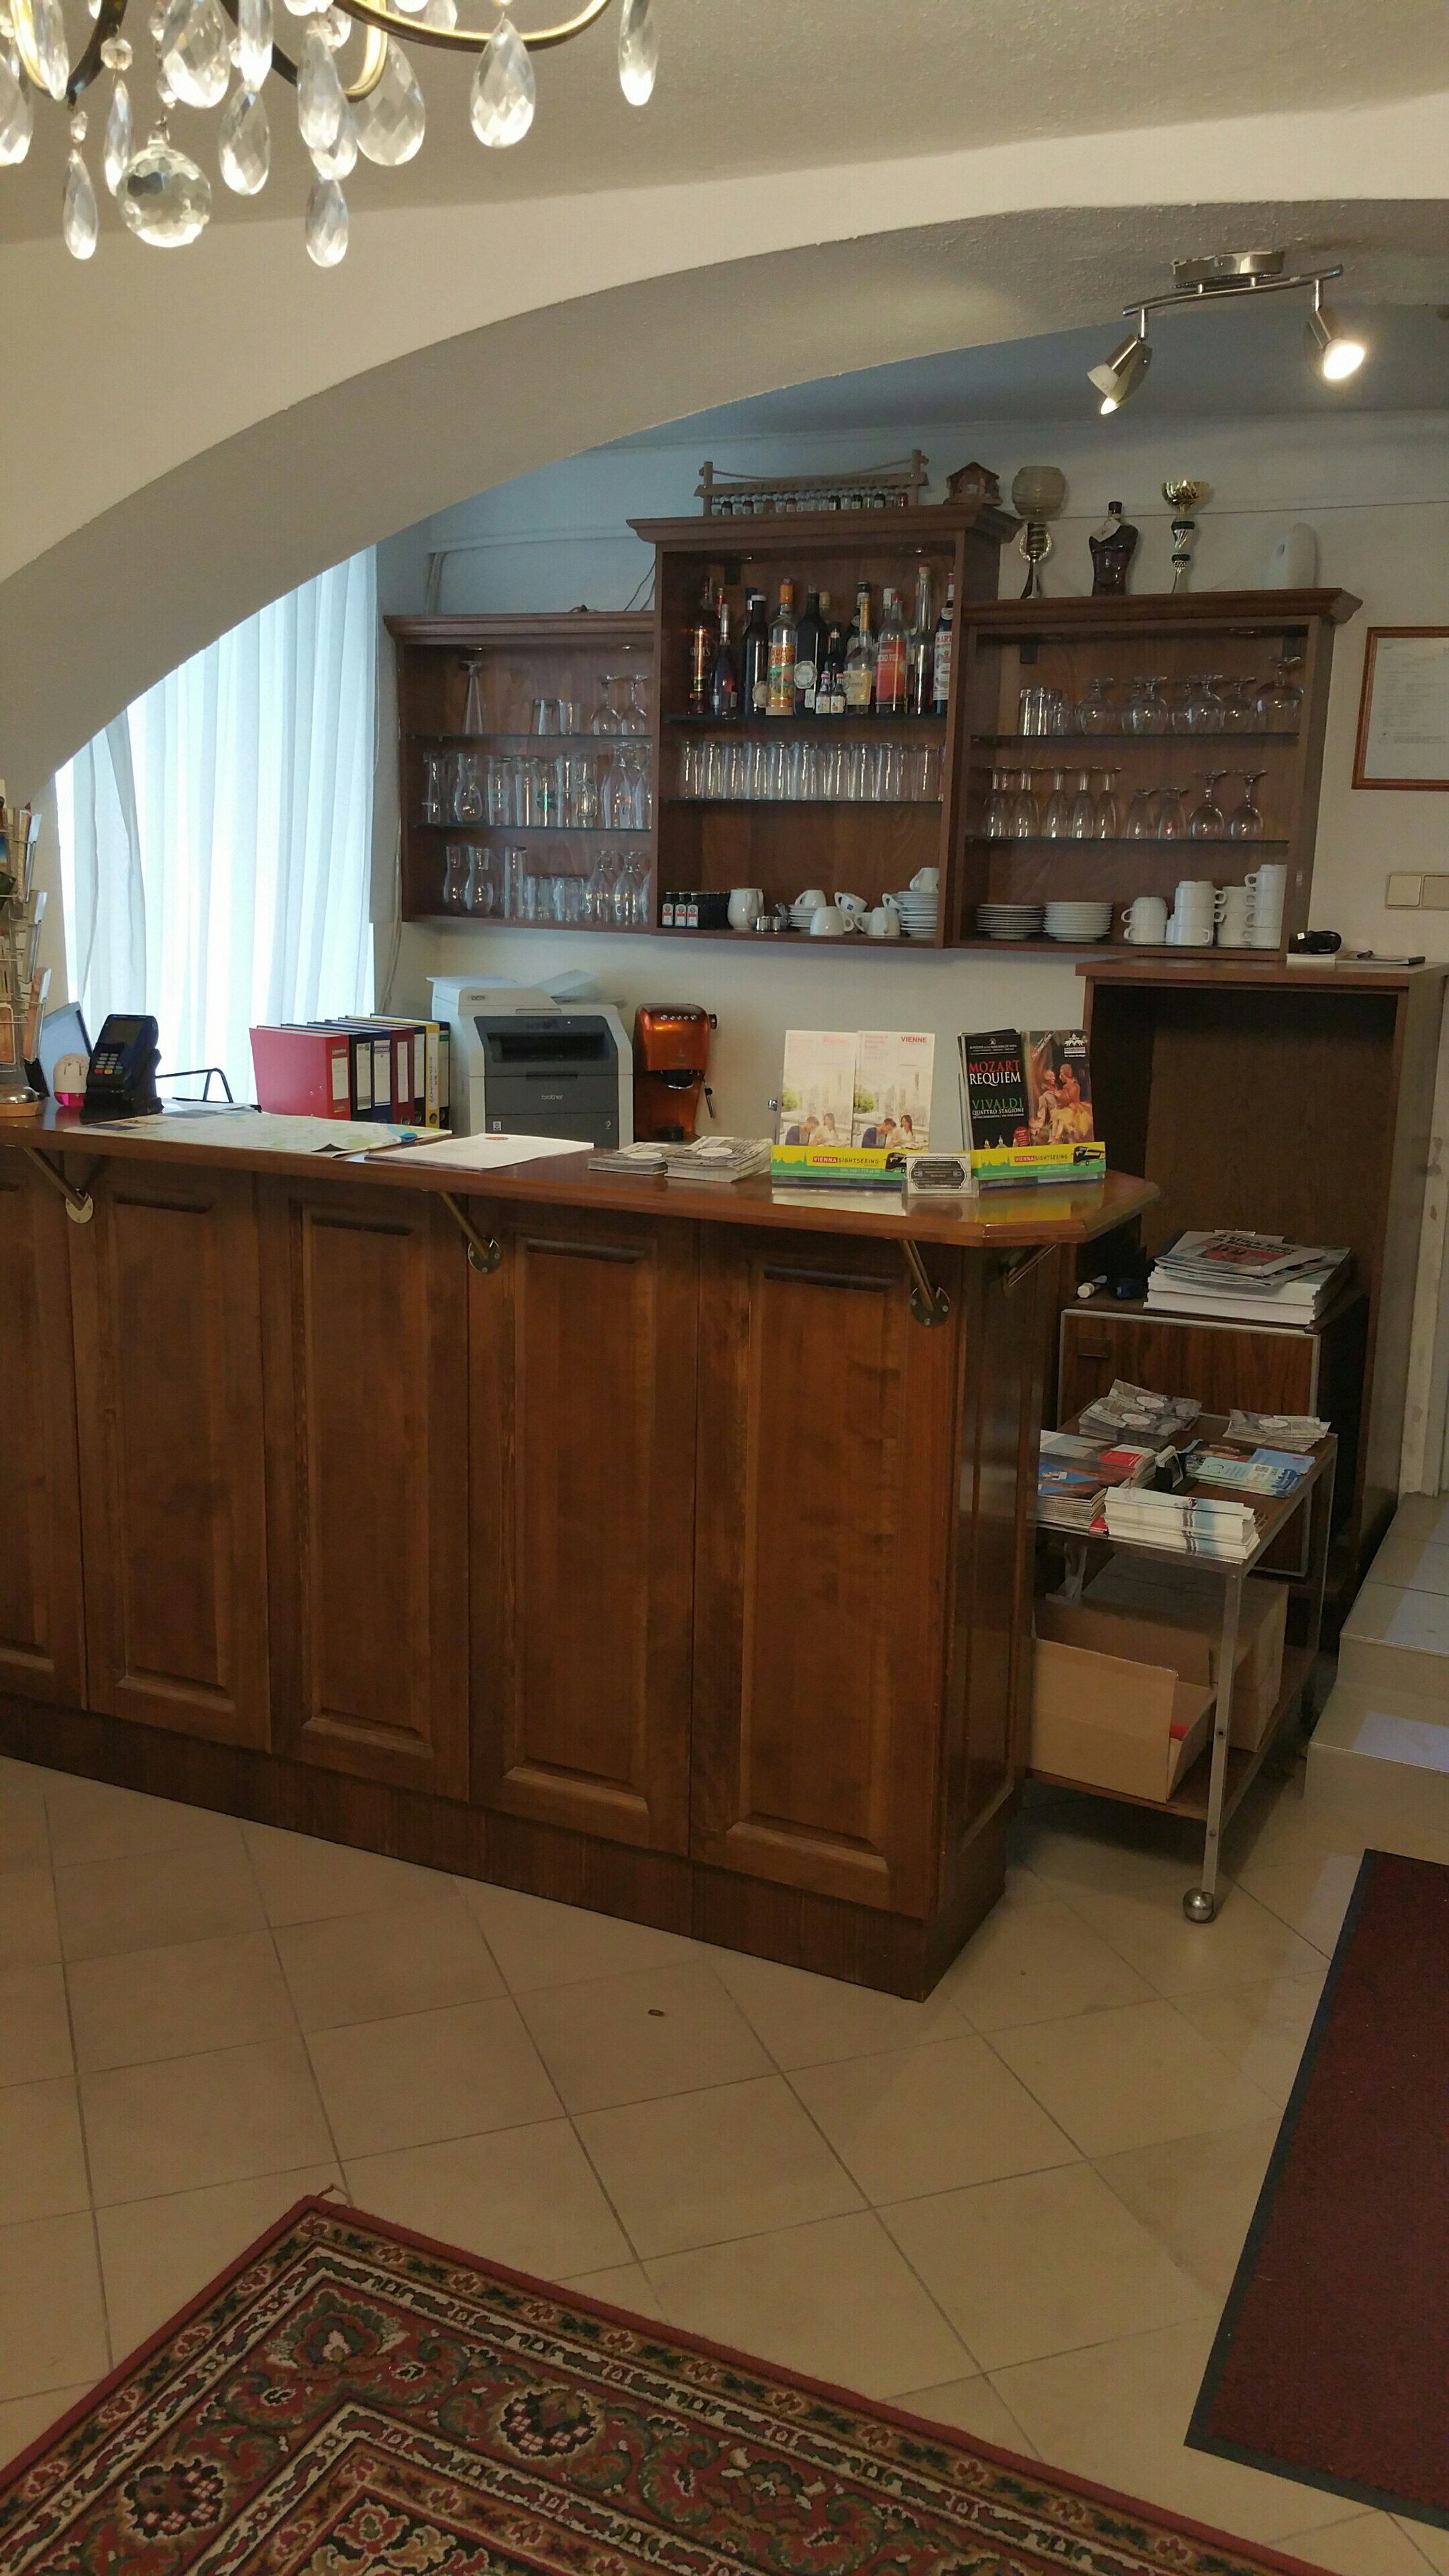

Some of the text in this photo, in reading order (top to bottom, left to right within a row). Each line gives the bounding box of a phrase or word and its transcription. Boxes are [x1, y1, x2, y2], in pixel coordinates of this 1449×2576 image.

[969, 1060, 1020, 1073] MOZART
[969, 1072, 1021, 1086] REQUIEM
[972, 1097, 1022, 1110] VIVALDI
